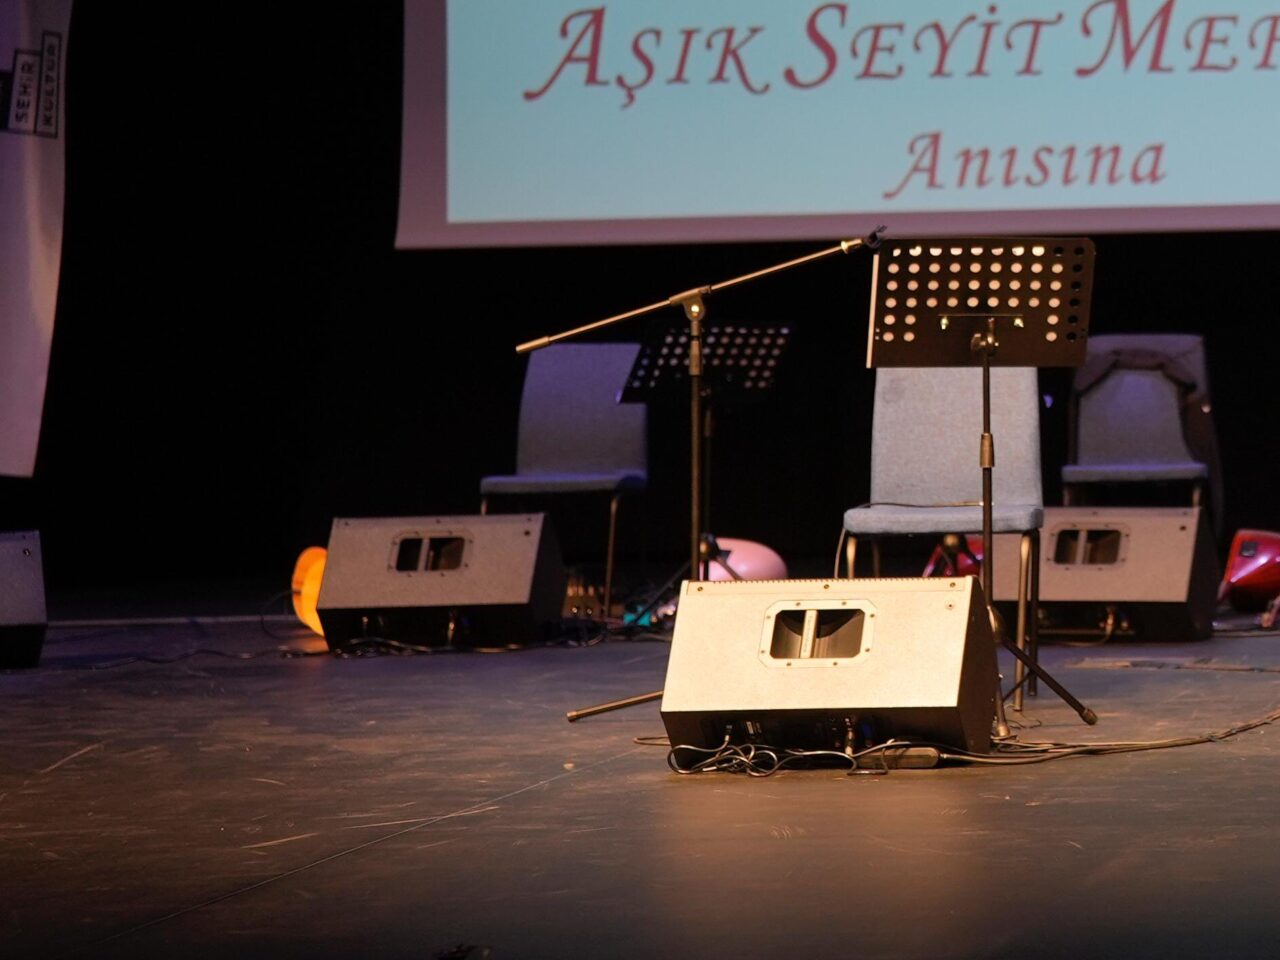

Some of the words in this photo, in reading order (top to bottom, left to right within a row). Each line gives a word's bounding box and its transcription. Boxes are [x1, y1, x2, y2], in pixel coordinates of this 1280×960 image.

[522, 5, 771, 109] AŞIK
[783, 2, 1065, 91] SEYİT
[882, 130, 1166, 200] Anısına
